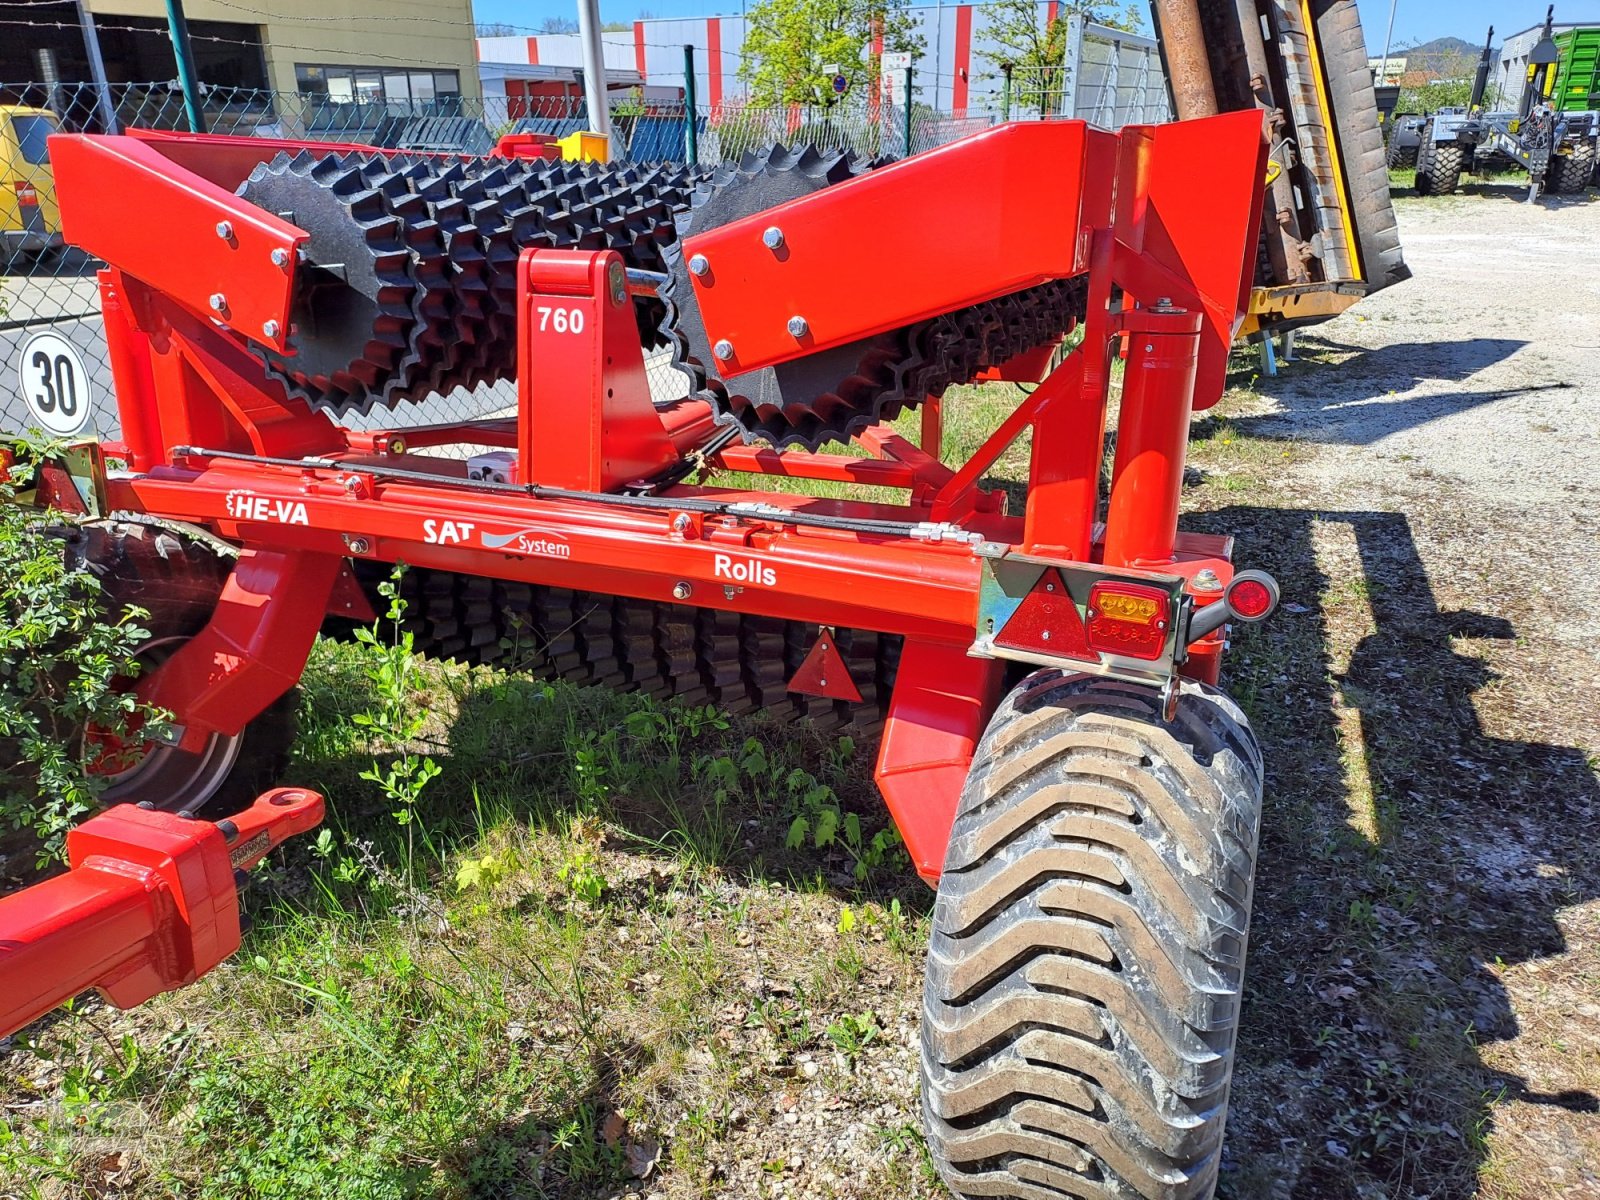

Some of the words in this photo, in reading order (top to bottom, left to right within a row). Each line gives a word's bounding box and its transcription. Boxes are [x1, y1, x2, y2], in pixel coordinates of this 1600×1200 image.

[537, 306, 584, 335] 760
[32, 351, 77, 417] 30
[235, 495, 310, 526] HE-VA
[423, 519, 475, 545] SAT
[518, 535, 570, 557] System
[713, 553, 777, 587] Rolls
